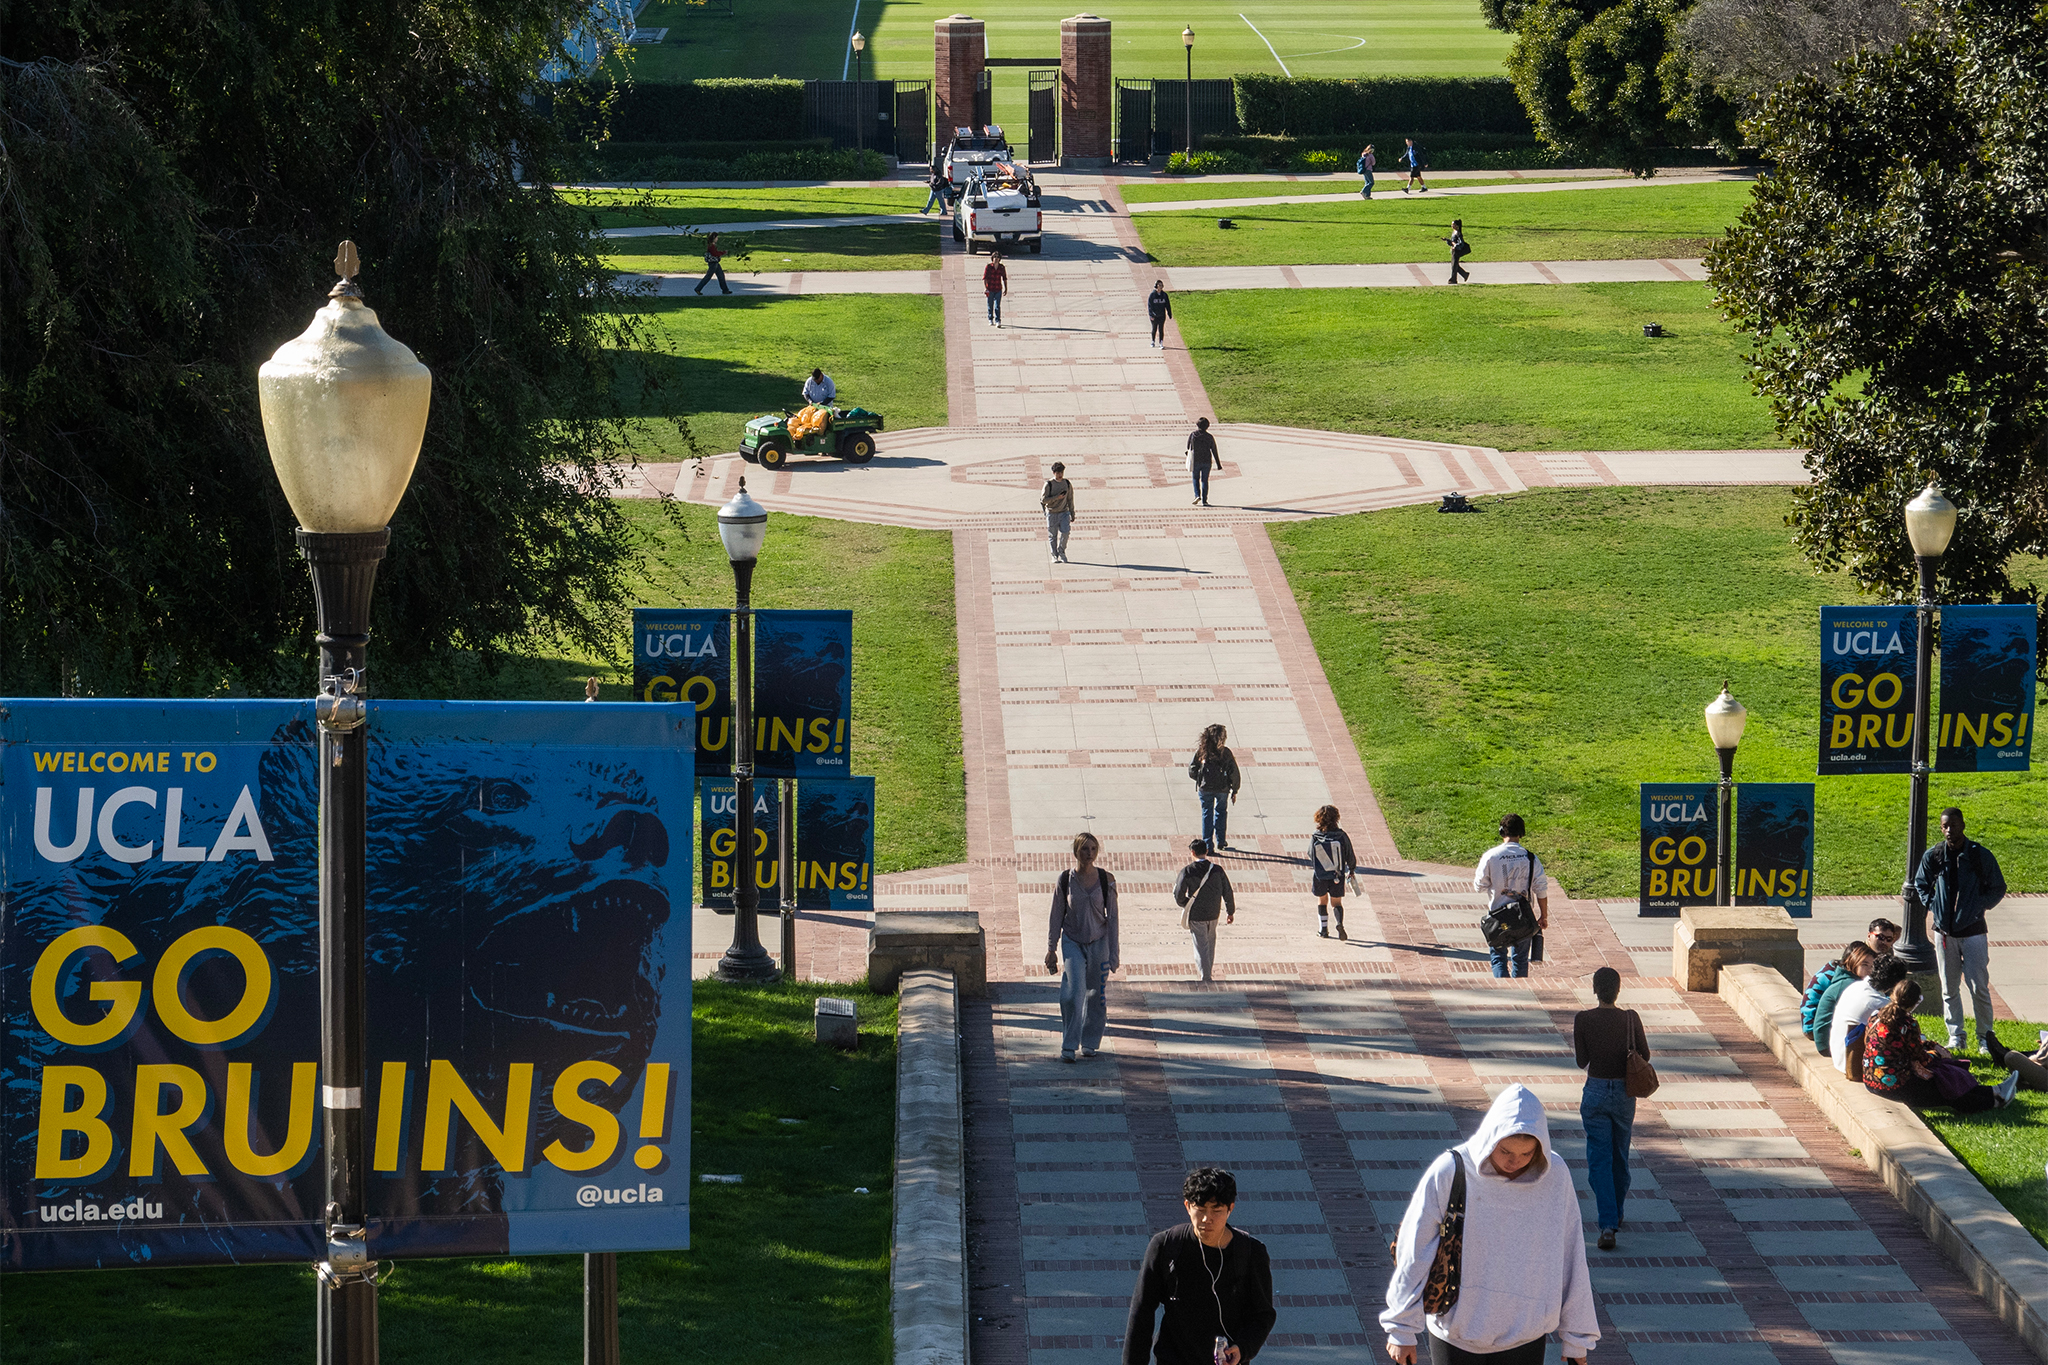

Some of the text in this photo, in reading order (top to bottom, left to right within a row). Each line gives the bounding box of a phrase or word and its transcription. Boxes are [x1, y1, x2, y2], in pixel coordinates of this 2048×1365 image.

[645, 633, 718, 658] UCLA
[1832, 630, 1905, 655] UCLA
[644, 675, 717, 712] GO
[1831, 672, 1903, 709] GO
[33, 751, 217, 773] WELCOME TO
[816, 757, 843, 765] @ucla
[1830, 754, 1867, 762] ucla.edu
[1997, 750, 2023, 758] @ucla
[34, 784, 275, 863] UCLA
[1650, 803, 1708, 822] UCLA
[1649, 836, 1707, 865] GO
[30, 925, 272, 1046] GO
[576, 1184, 664, 1207] @ucla
[40, 1197, 163, 1223] ucla.edu
